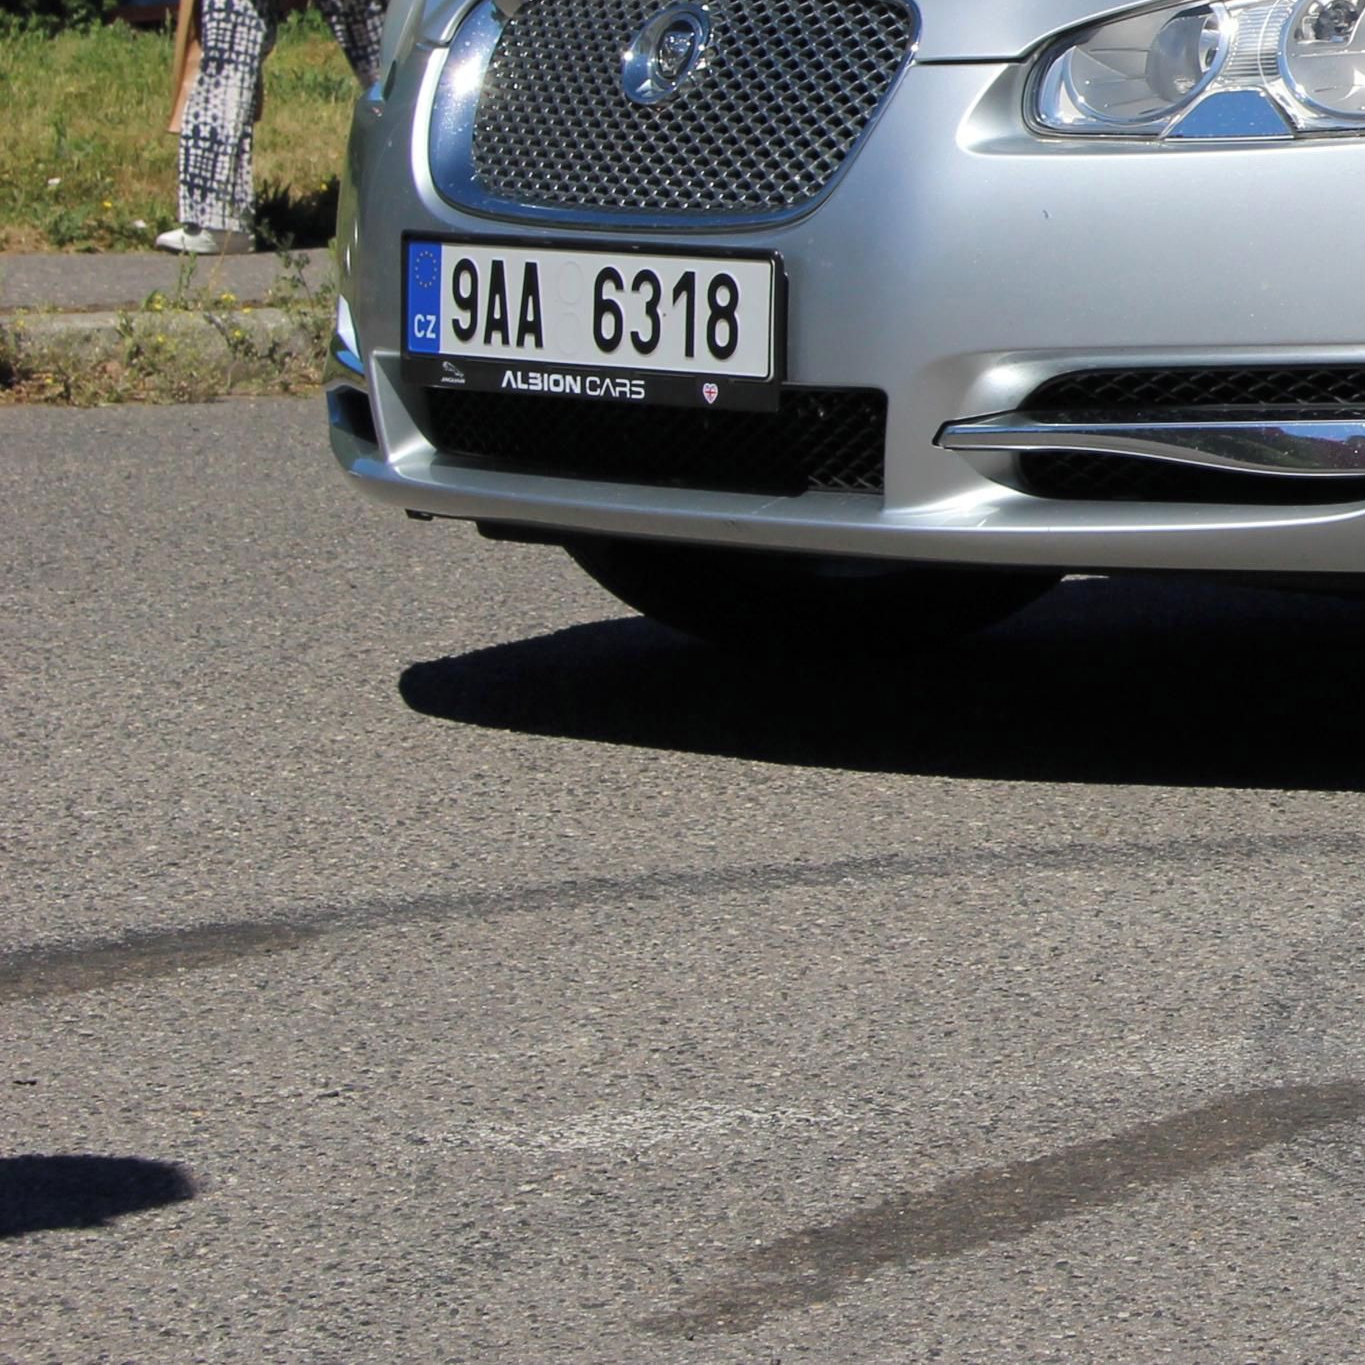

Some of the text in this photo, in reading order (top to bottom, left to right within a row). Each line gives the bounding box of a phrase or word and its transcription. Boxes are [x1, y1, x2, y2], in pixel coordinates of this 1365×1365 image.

[452, 258, 739, 360] 9AA 6318
[414, 314, 436, 338] CZ
[502, 370, 645, 399] ALBION CARS
